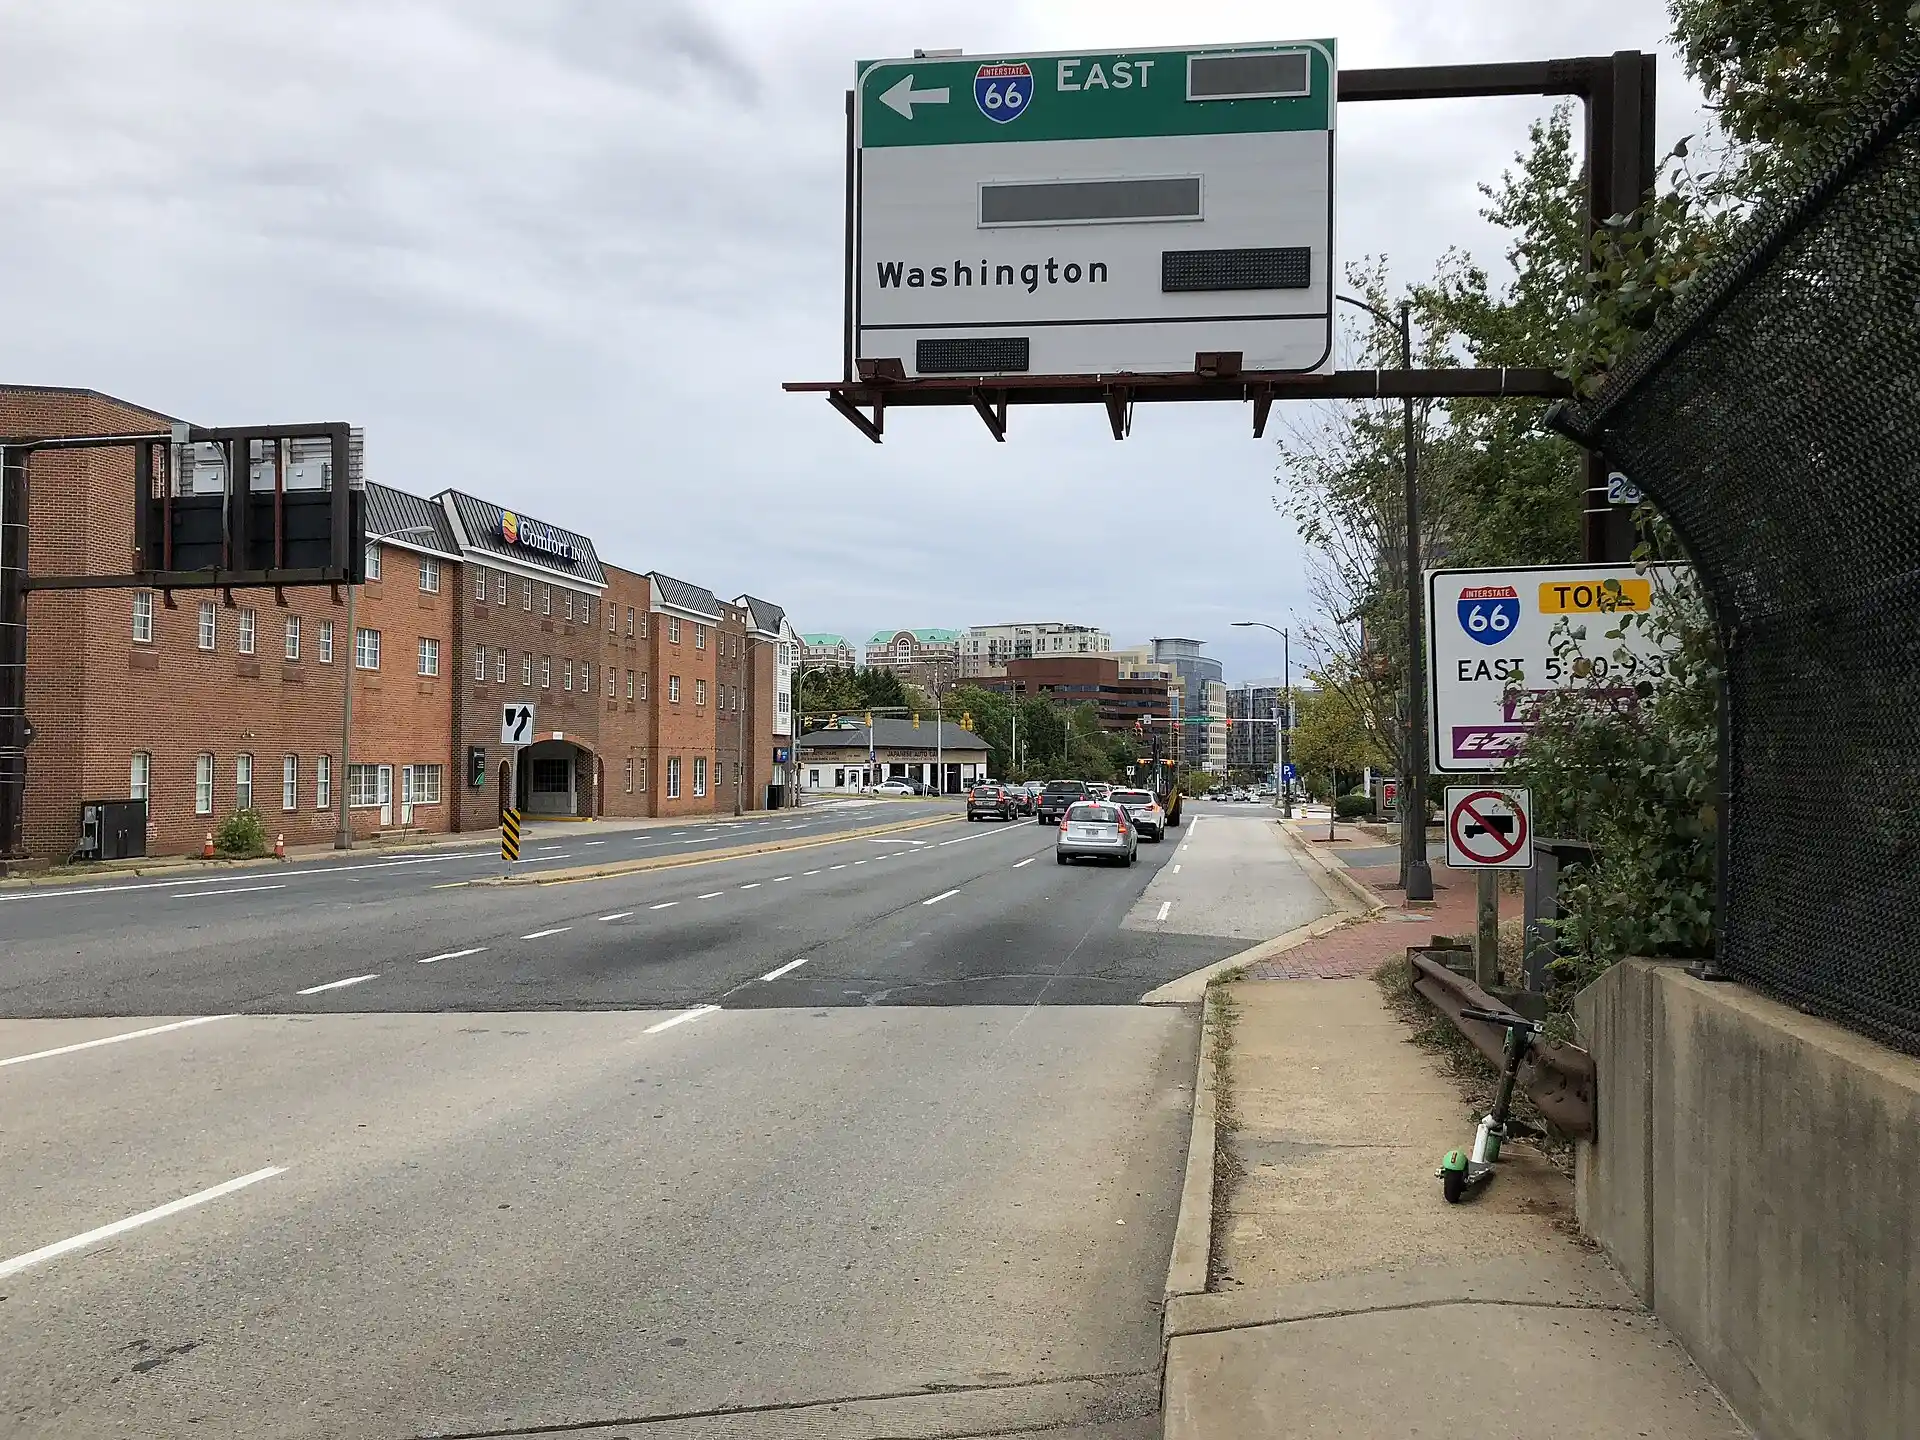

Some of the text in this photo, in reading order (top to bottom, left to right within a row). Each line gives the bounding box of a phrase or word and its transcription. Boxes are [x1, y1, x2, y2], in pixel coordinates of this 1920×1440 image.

[983, 66, 1024, 76] INTERSTATE
[1057, 59, 1155, 92] EAST
[984, 81, 1023, 109] 66
[876, 256, 1108, 293] Washington
[520, 521, 569, 558] Comfort
[1465, 588, 1511, 598] INTERSTATE
[1468, 604, 1510, 632] 66
[1458, 658, 1524, 682] EAST
